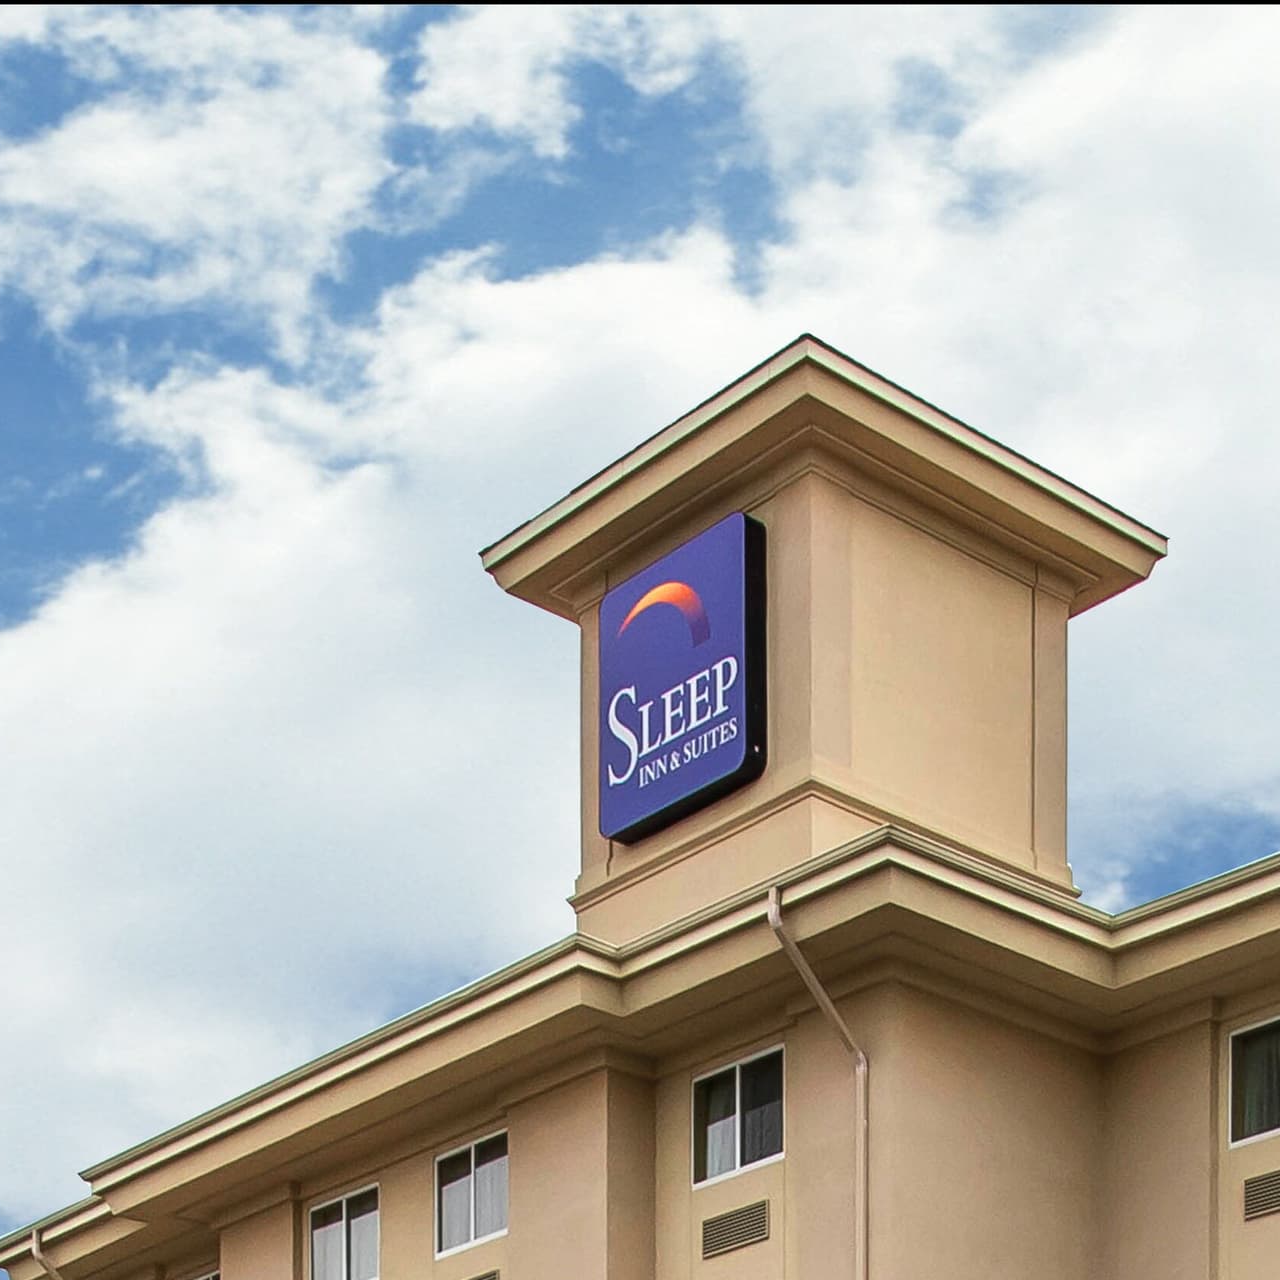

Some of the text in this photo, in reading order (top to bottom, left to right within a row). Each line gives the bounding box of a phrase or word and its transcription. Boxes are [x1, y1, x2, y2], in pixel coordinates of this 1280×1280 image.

[607, 656, 738, 787] SLEEP
[639, 717, 738, 788] INN & SUITES
